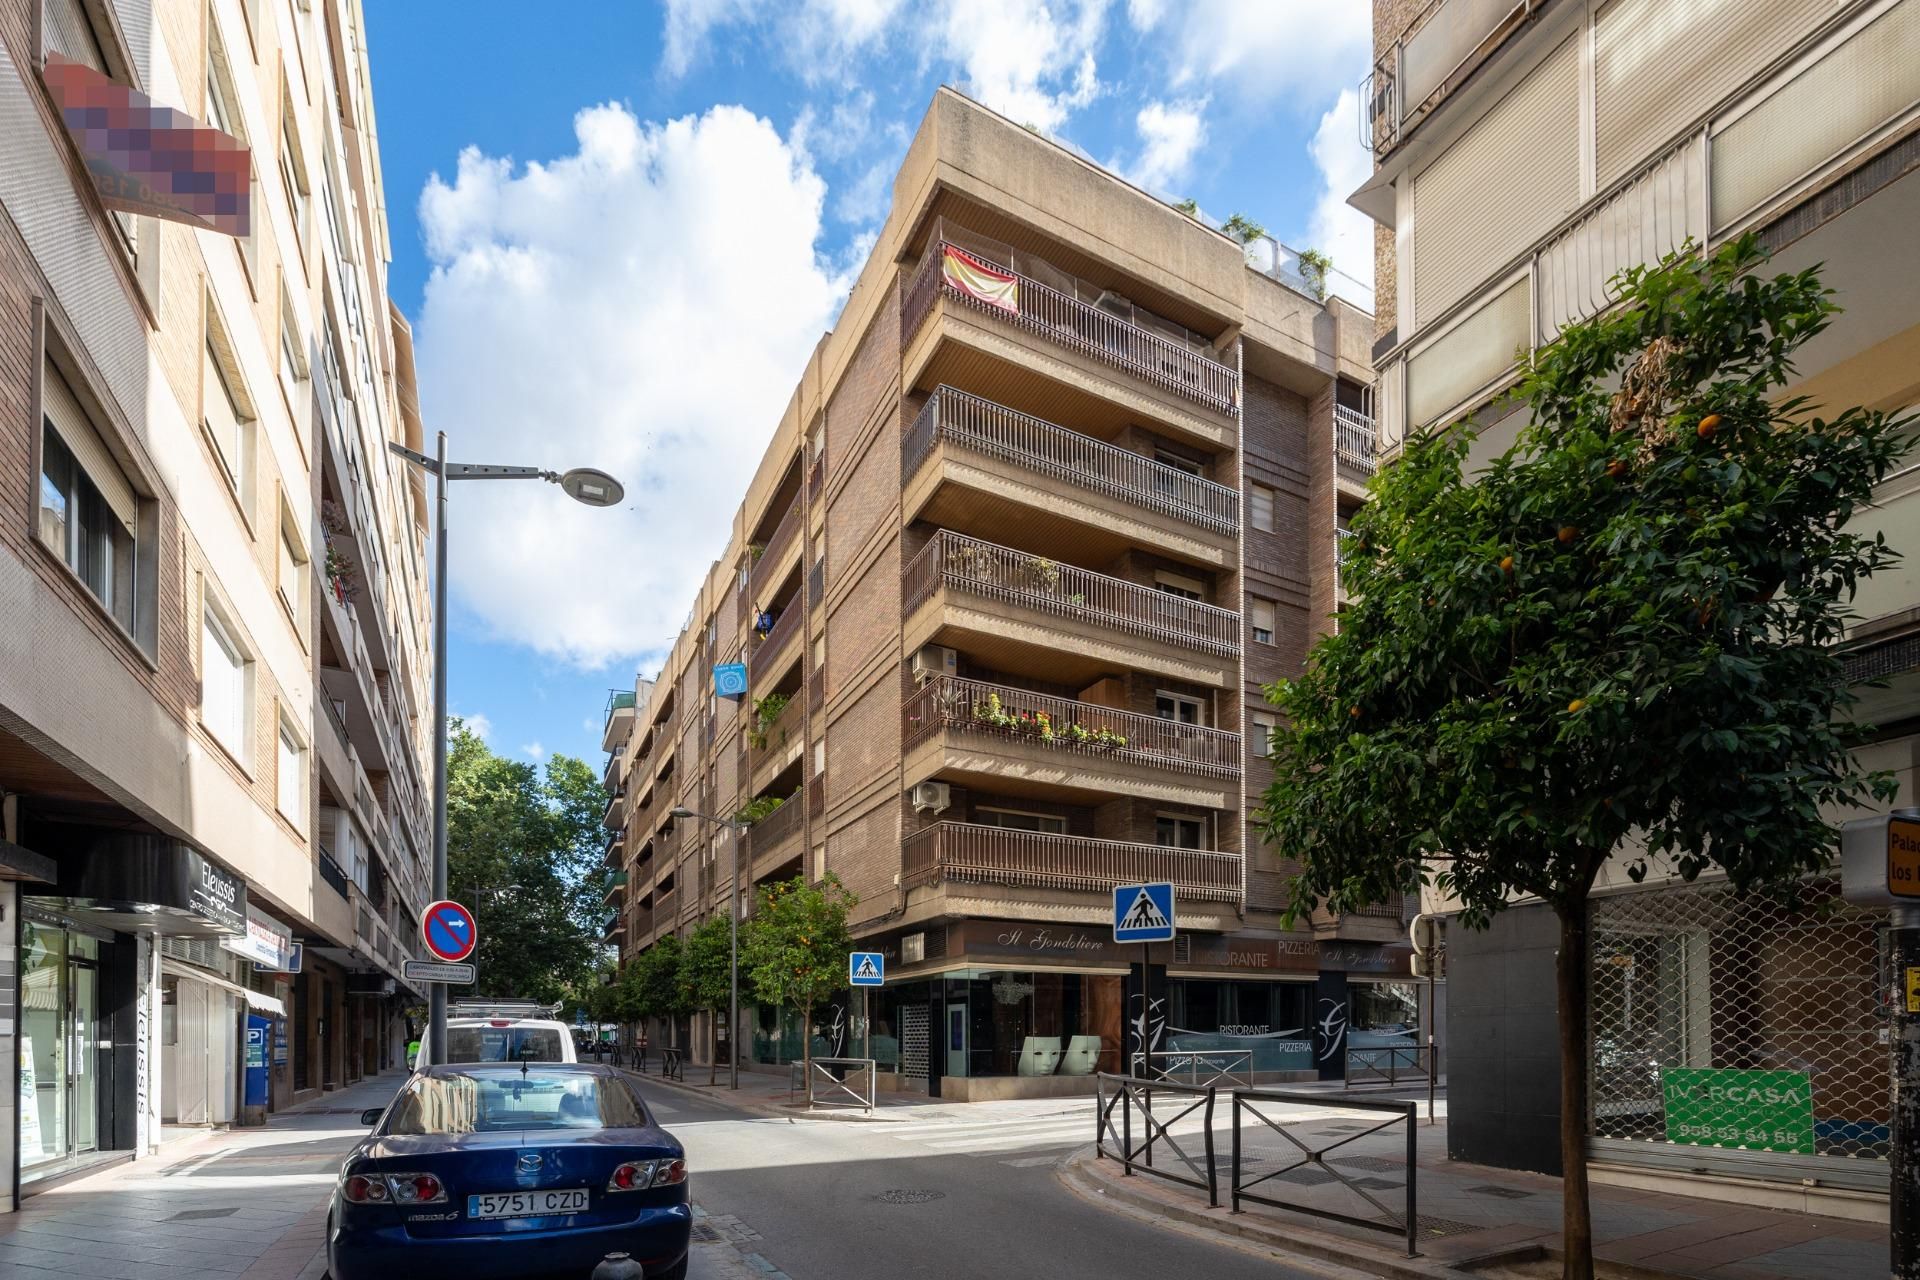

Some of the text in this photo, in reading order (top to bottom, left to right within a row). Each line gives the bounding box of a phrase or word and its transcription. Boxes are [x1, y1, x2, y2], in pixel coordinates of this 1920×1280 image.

[1892, 861, 1912, 881] los
[203, 861, 236, 903] Eleussis
[1030, 928, 1104, 950] Gondoliere
[1278, 940, 1320, 955] PIZZERIA
[248, 1031, 260, 1042] P
[1219, 1024, 1270, 1035] RISTORANTE
[137, 988, 148, 1115] Eleussis
[1279, 1042, 1312, 1053] PIZZERIA
[1679, 1124, 1712, 1138] 958
[484, 1194, 535, 1213] 5751
[546, 1192, 584, 1210] CZD
